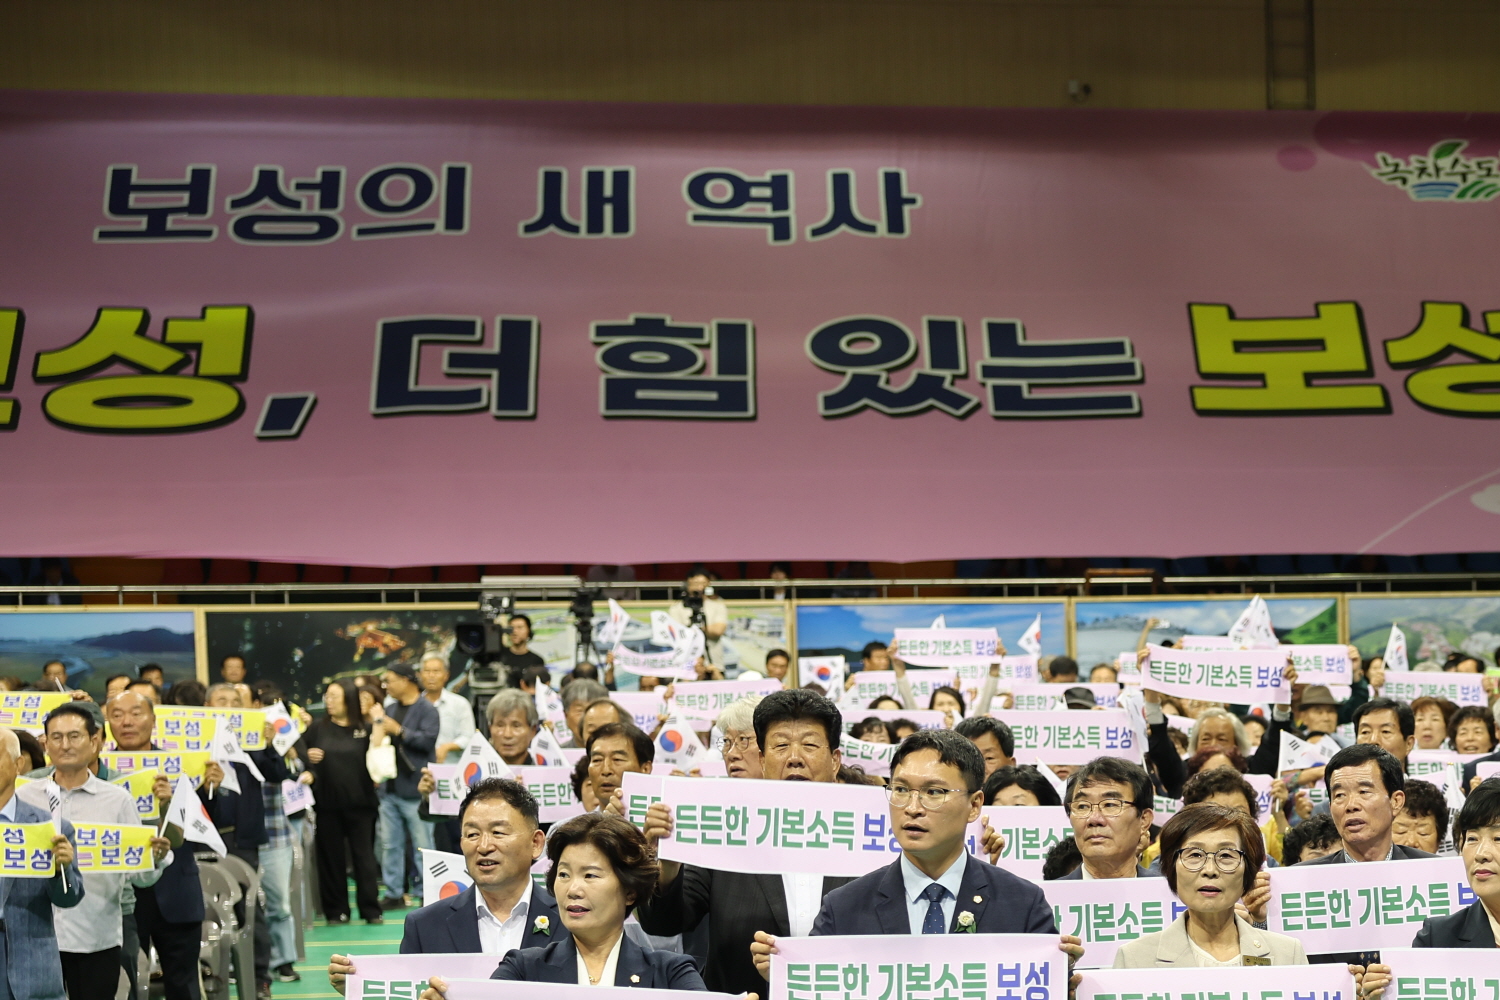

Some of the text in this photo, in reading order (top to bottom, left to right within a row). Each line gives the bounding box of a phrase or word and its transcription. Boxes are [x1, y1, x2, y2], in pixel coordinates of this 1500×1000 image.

[1375, 149, 1500, 191] 녹차수도
[94, 163, 922, 244] 보성의 새 역사
[370, 315, 540, 419] 더
[590, 312, 758, 420] 힘
[806, 314, 1143, 420] 있는
[899, 639, 996, 656] 든든한 기본소득 보성
[1149, 660, 1192, 685] 든든한
[1196, 663, 1252, 688] 기본소득
[1256, 666, 1283, 688] 보성
[164, 720, 201, 737] 보성
[1010, 725, 1133, 749] 든한 기본소득 보성
[2, 828, 25, 844] 성
[77, 829, 121, 847] 보성
[675, 804, 749, 847] 든든한
[755, 808, 855, 851] 기본소득
[3, 847, 53, 871] 보성
[102, 846, 144, 867] 보성
[1280, 882, 1450, 931] 든든한 기본소득
[1069, 901, 1164, 943] 기본소득
